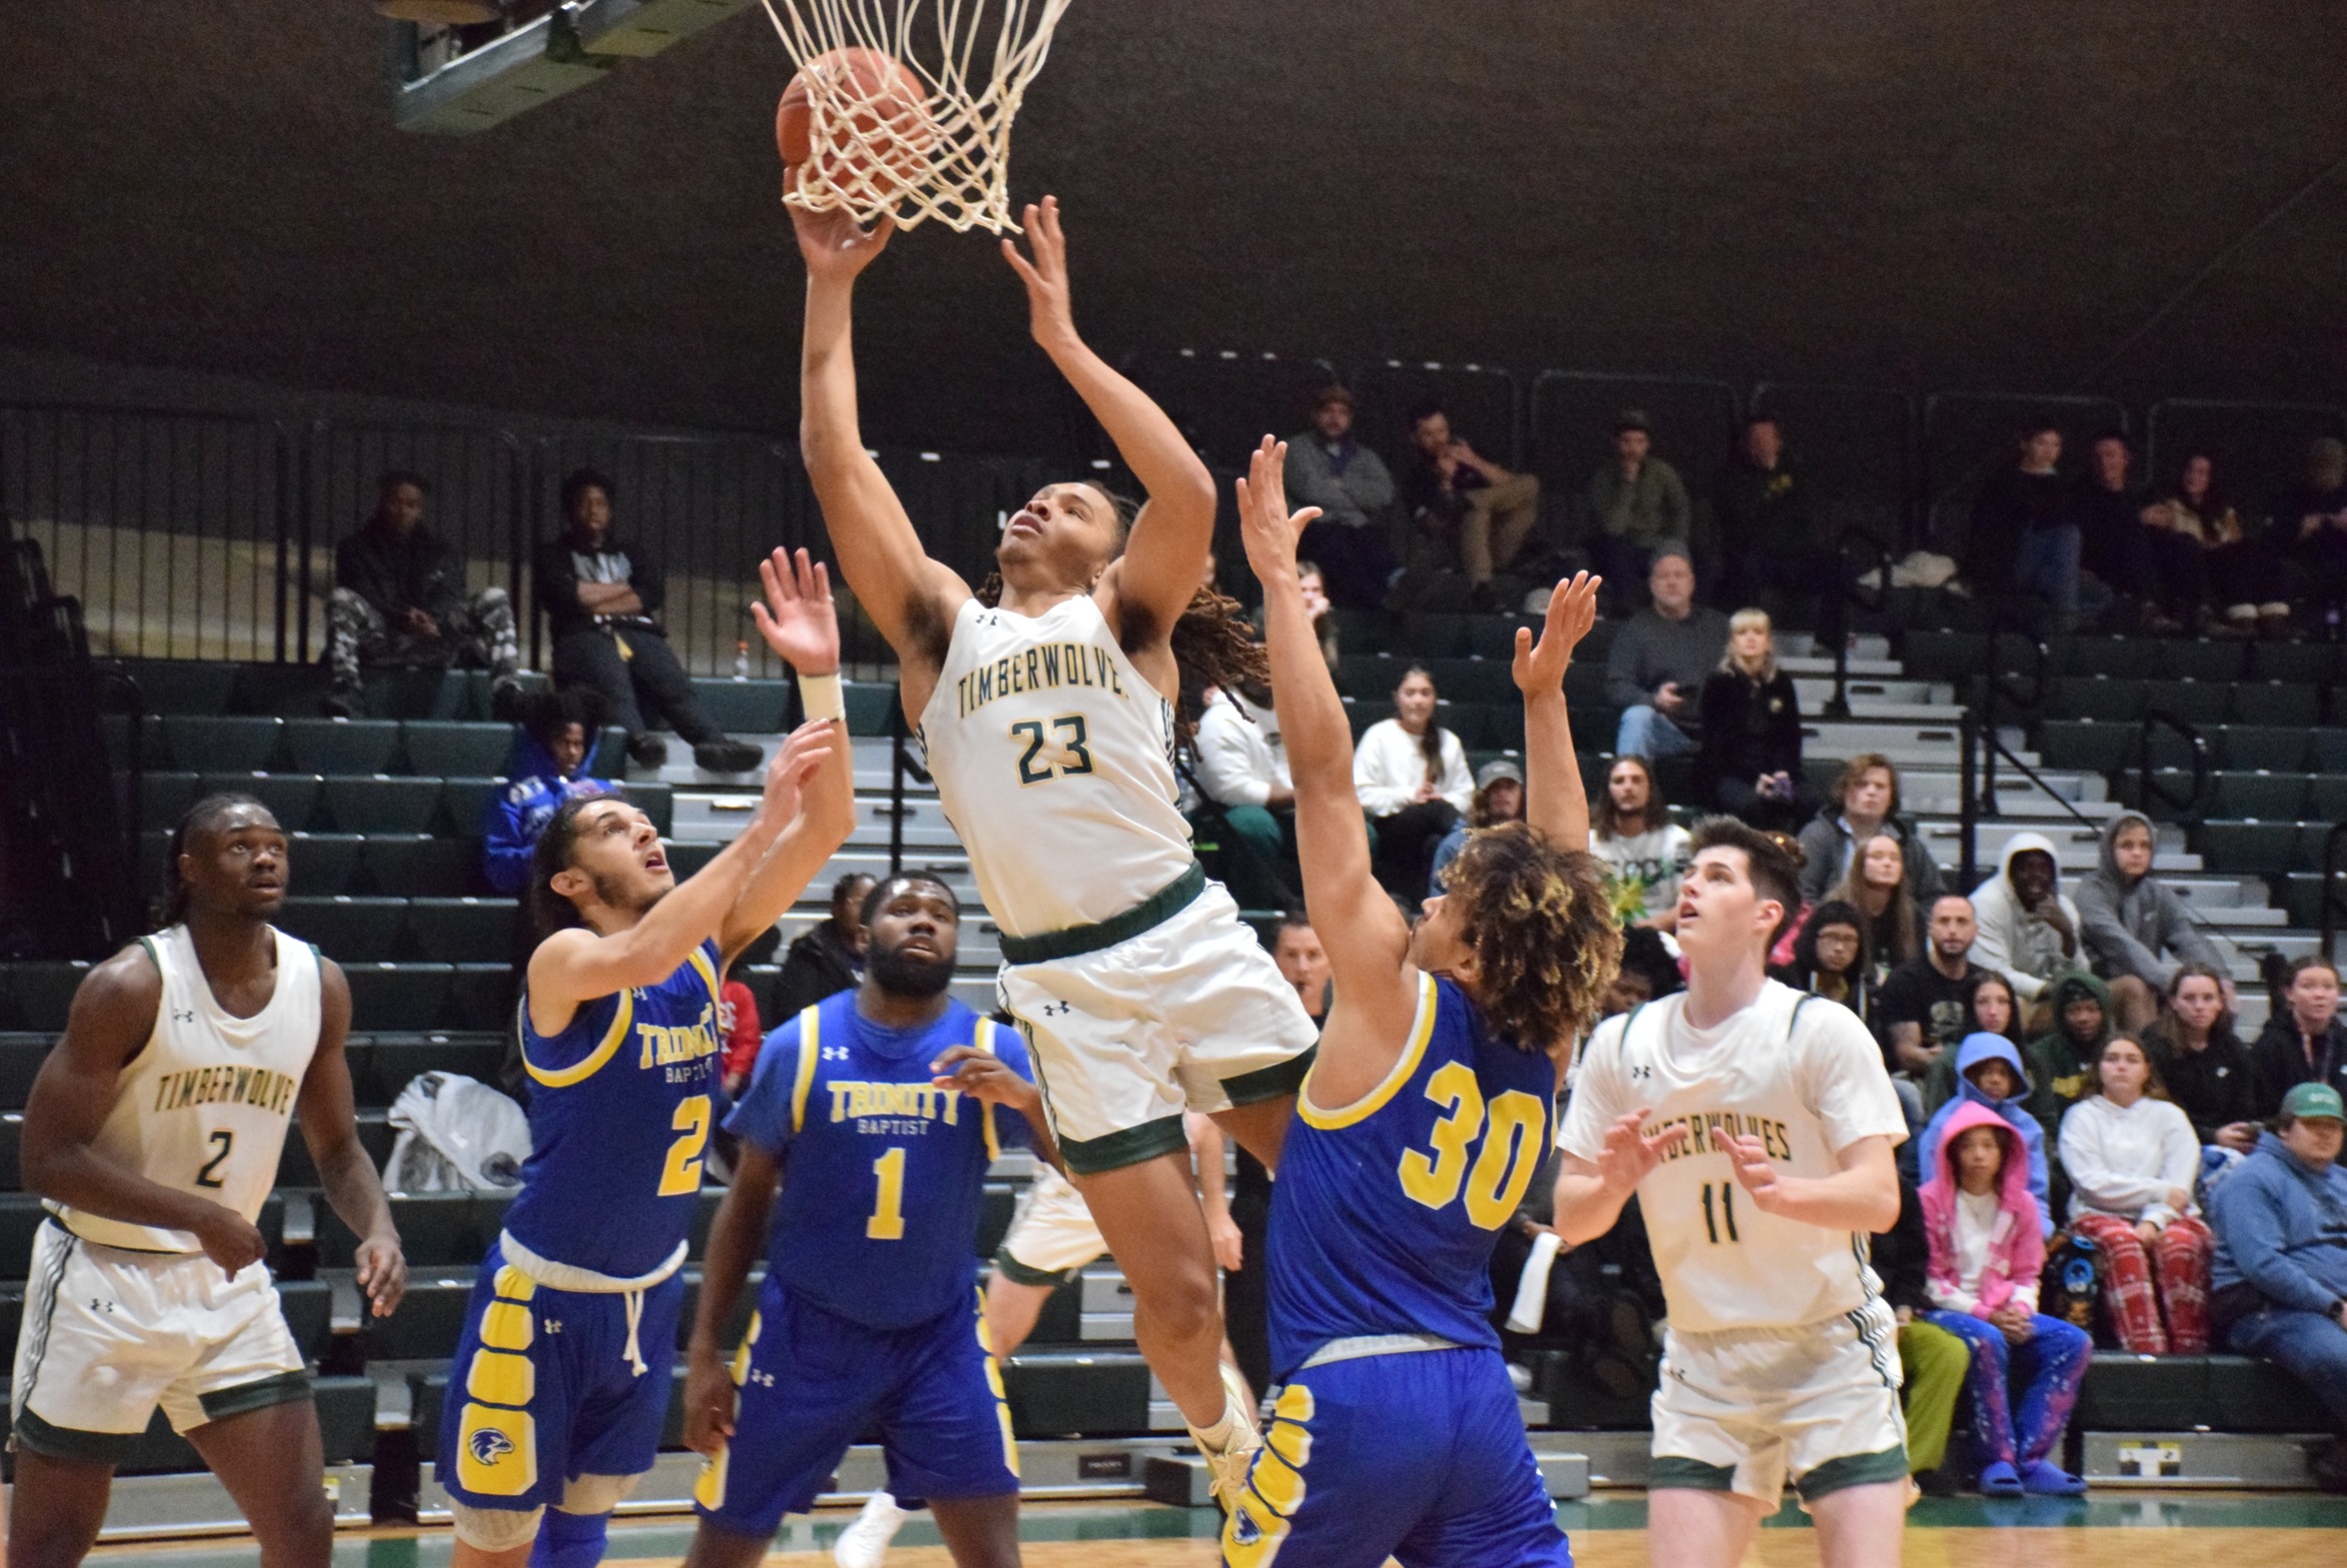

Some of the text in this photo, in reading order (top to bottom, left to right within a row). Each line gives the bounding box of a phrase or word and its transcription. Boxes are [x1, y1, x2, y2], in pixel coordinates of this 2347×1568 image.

[957, 642, 1131, 720] TIMBERWOLVE
[1009, 713, 1097, 788] 23
[826, 1080, 963, 1126] TRINITY
[857, 1118, 930, 1135] BAPTIST
[196, 1127, 235, 1189] 2
[657, 1093, 712, 1197] 2
[1397, 1059, 1546, 1231] 30
[866, 1146, 907, 1240] 1
[1701, 1179, 1740, 1245] 11
